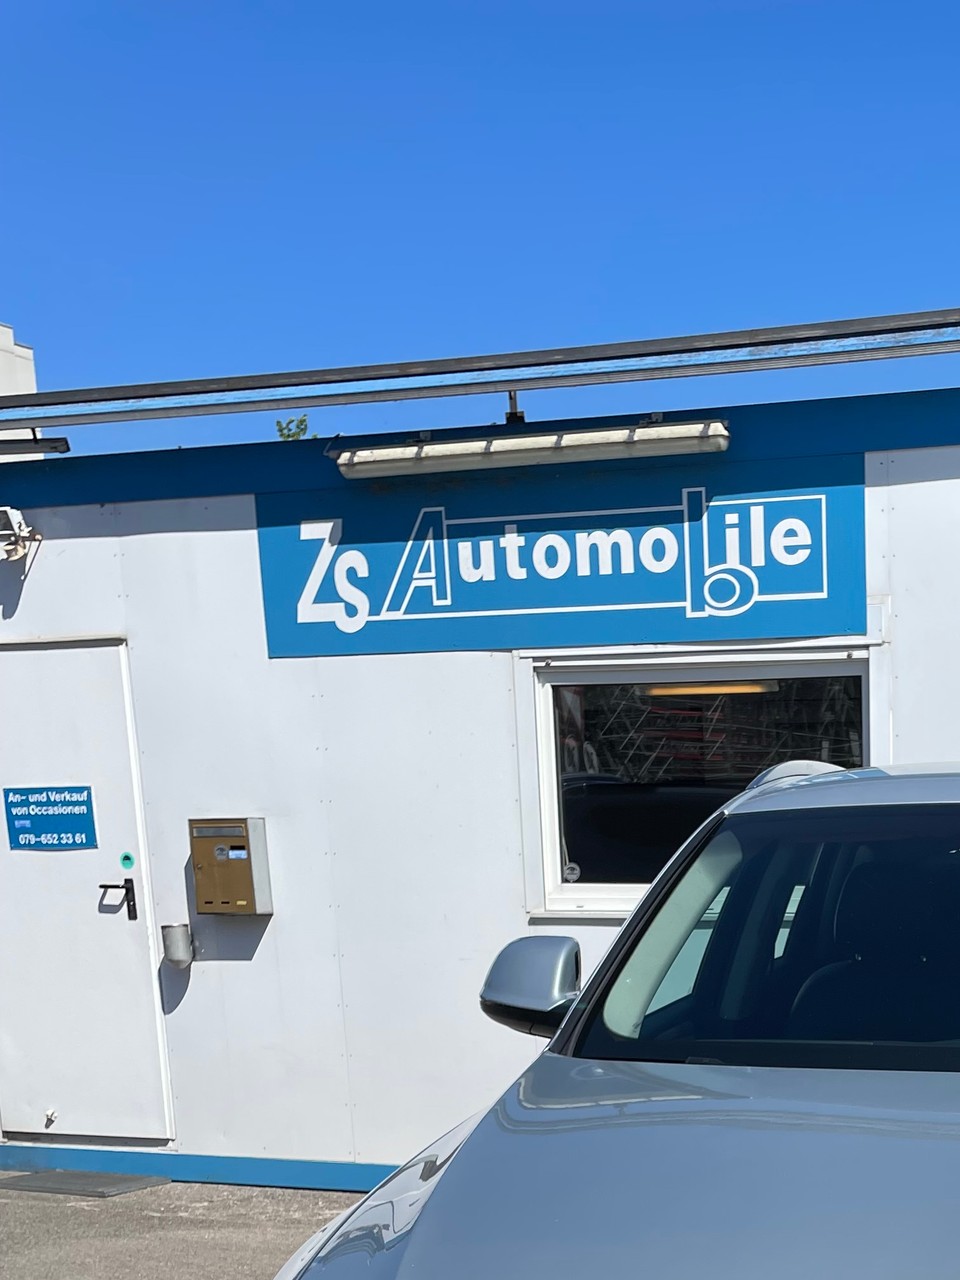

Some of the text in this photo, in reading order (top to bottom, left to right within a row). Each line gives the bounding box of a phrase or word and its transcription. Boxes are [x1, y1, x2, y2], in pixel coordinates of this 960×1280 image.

[380, 487, 813, 618] Automobile
[28, 791, 47, 802] und
[48, 790, 88, 802] Verkauf
[11, 803, 87, 815] von Occasionen
[60, 833, 73, 844] 33
[75, 833, 86, 843] 61
